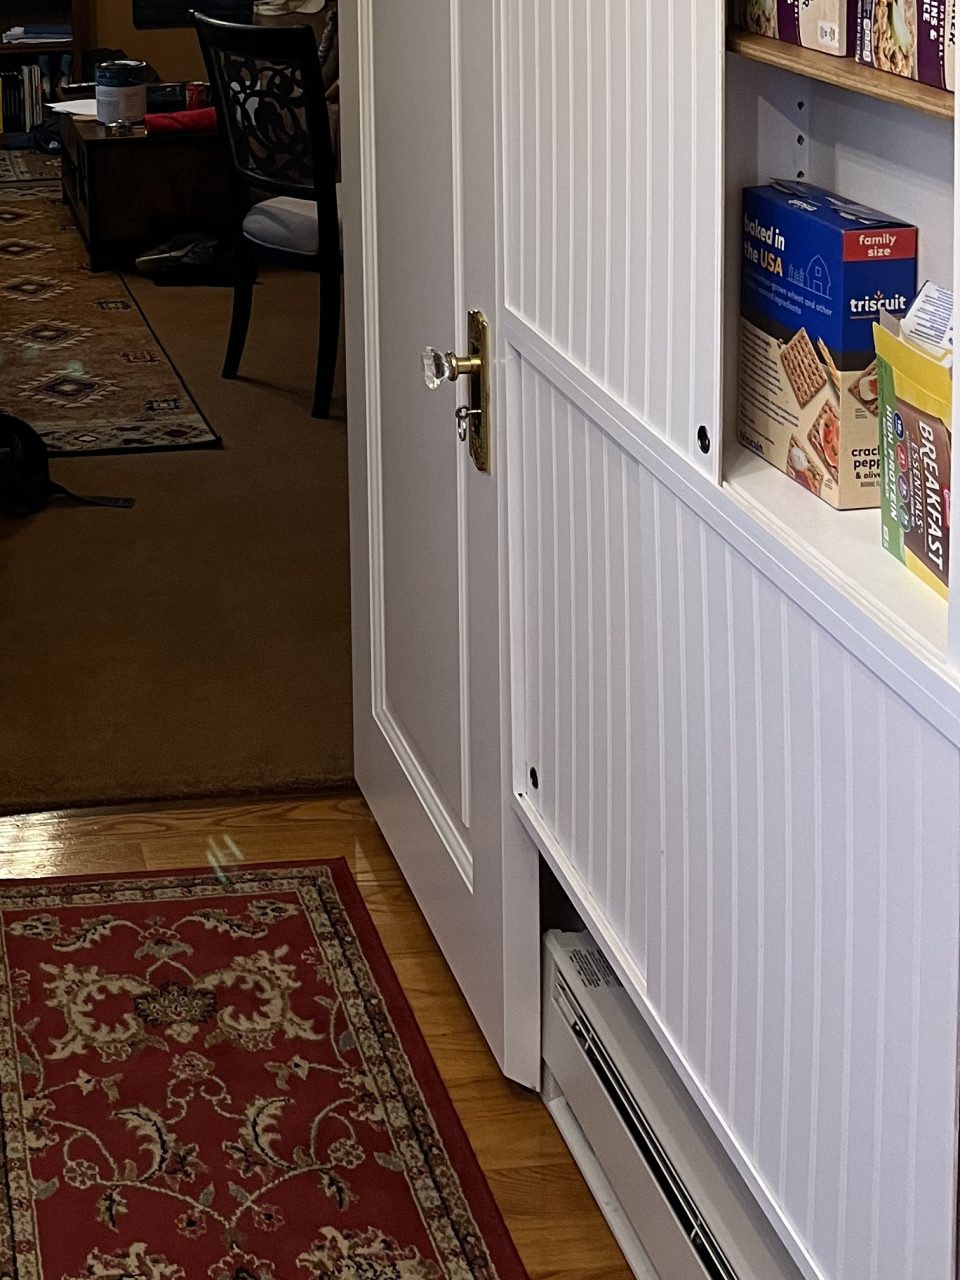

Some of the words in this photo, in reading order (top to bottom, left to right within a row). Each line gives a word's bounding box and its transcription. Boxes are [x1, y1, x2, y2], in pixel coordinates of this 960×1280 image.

[928, 28, 939, 41] &
[743, 213, 774, 246] baked
[774, 228, 786, 251] in
[859, 234, 897, 247] family
[743, 240, 759, 264] the
[760, 248, 784, 277] USA
[867, 247, 892, 257] size
[850, 294, 907, 312] triscuit
[886, 404, 895, 447] HIGH
[855, 471, 862, 480] &
[888, 453, 898, 522] PROTEIN
[911, 442, 924, 528] ESSENTIALS
[919, 420, 944, 571] BREAKFAST
